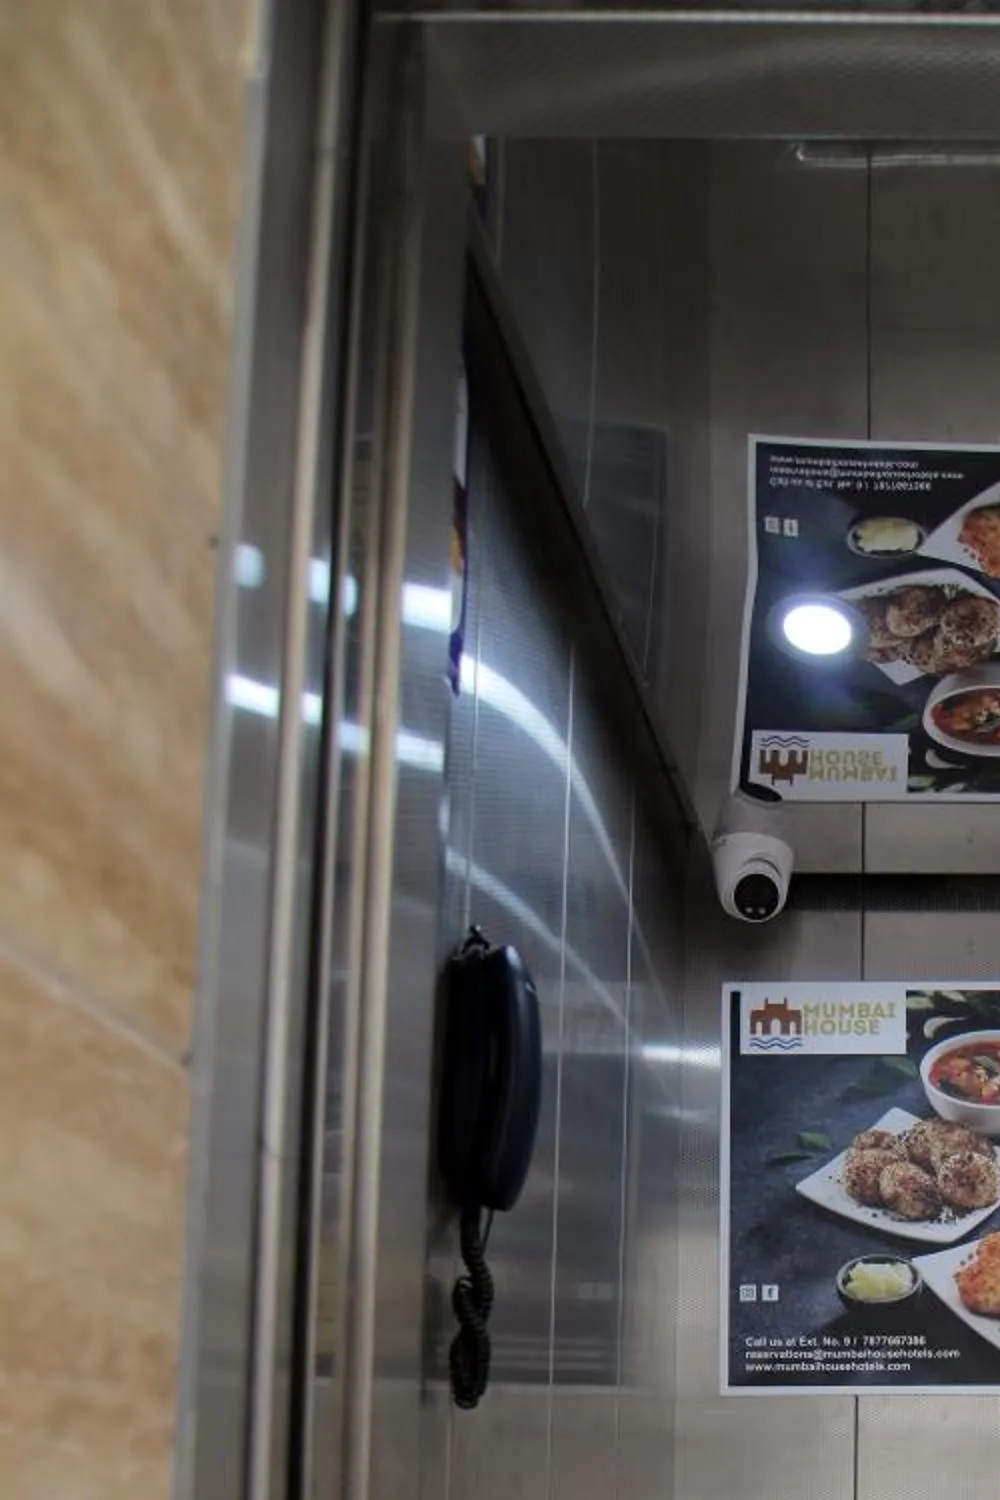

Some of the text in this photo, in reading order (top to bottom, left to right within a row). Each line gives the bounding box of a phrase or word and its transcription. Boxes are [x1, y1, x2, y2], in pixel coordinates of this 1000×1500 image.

[802, 1001, 897, 1019] MUMBAI
[803, 1018, 881, 1036] HOUSE
[745, 1336, 767, 1347] Call
[769, 1337, 783, 1347] us
